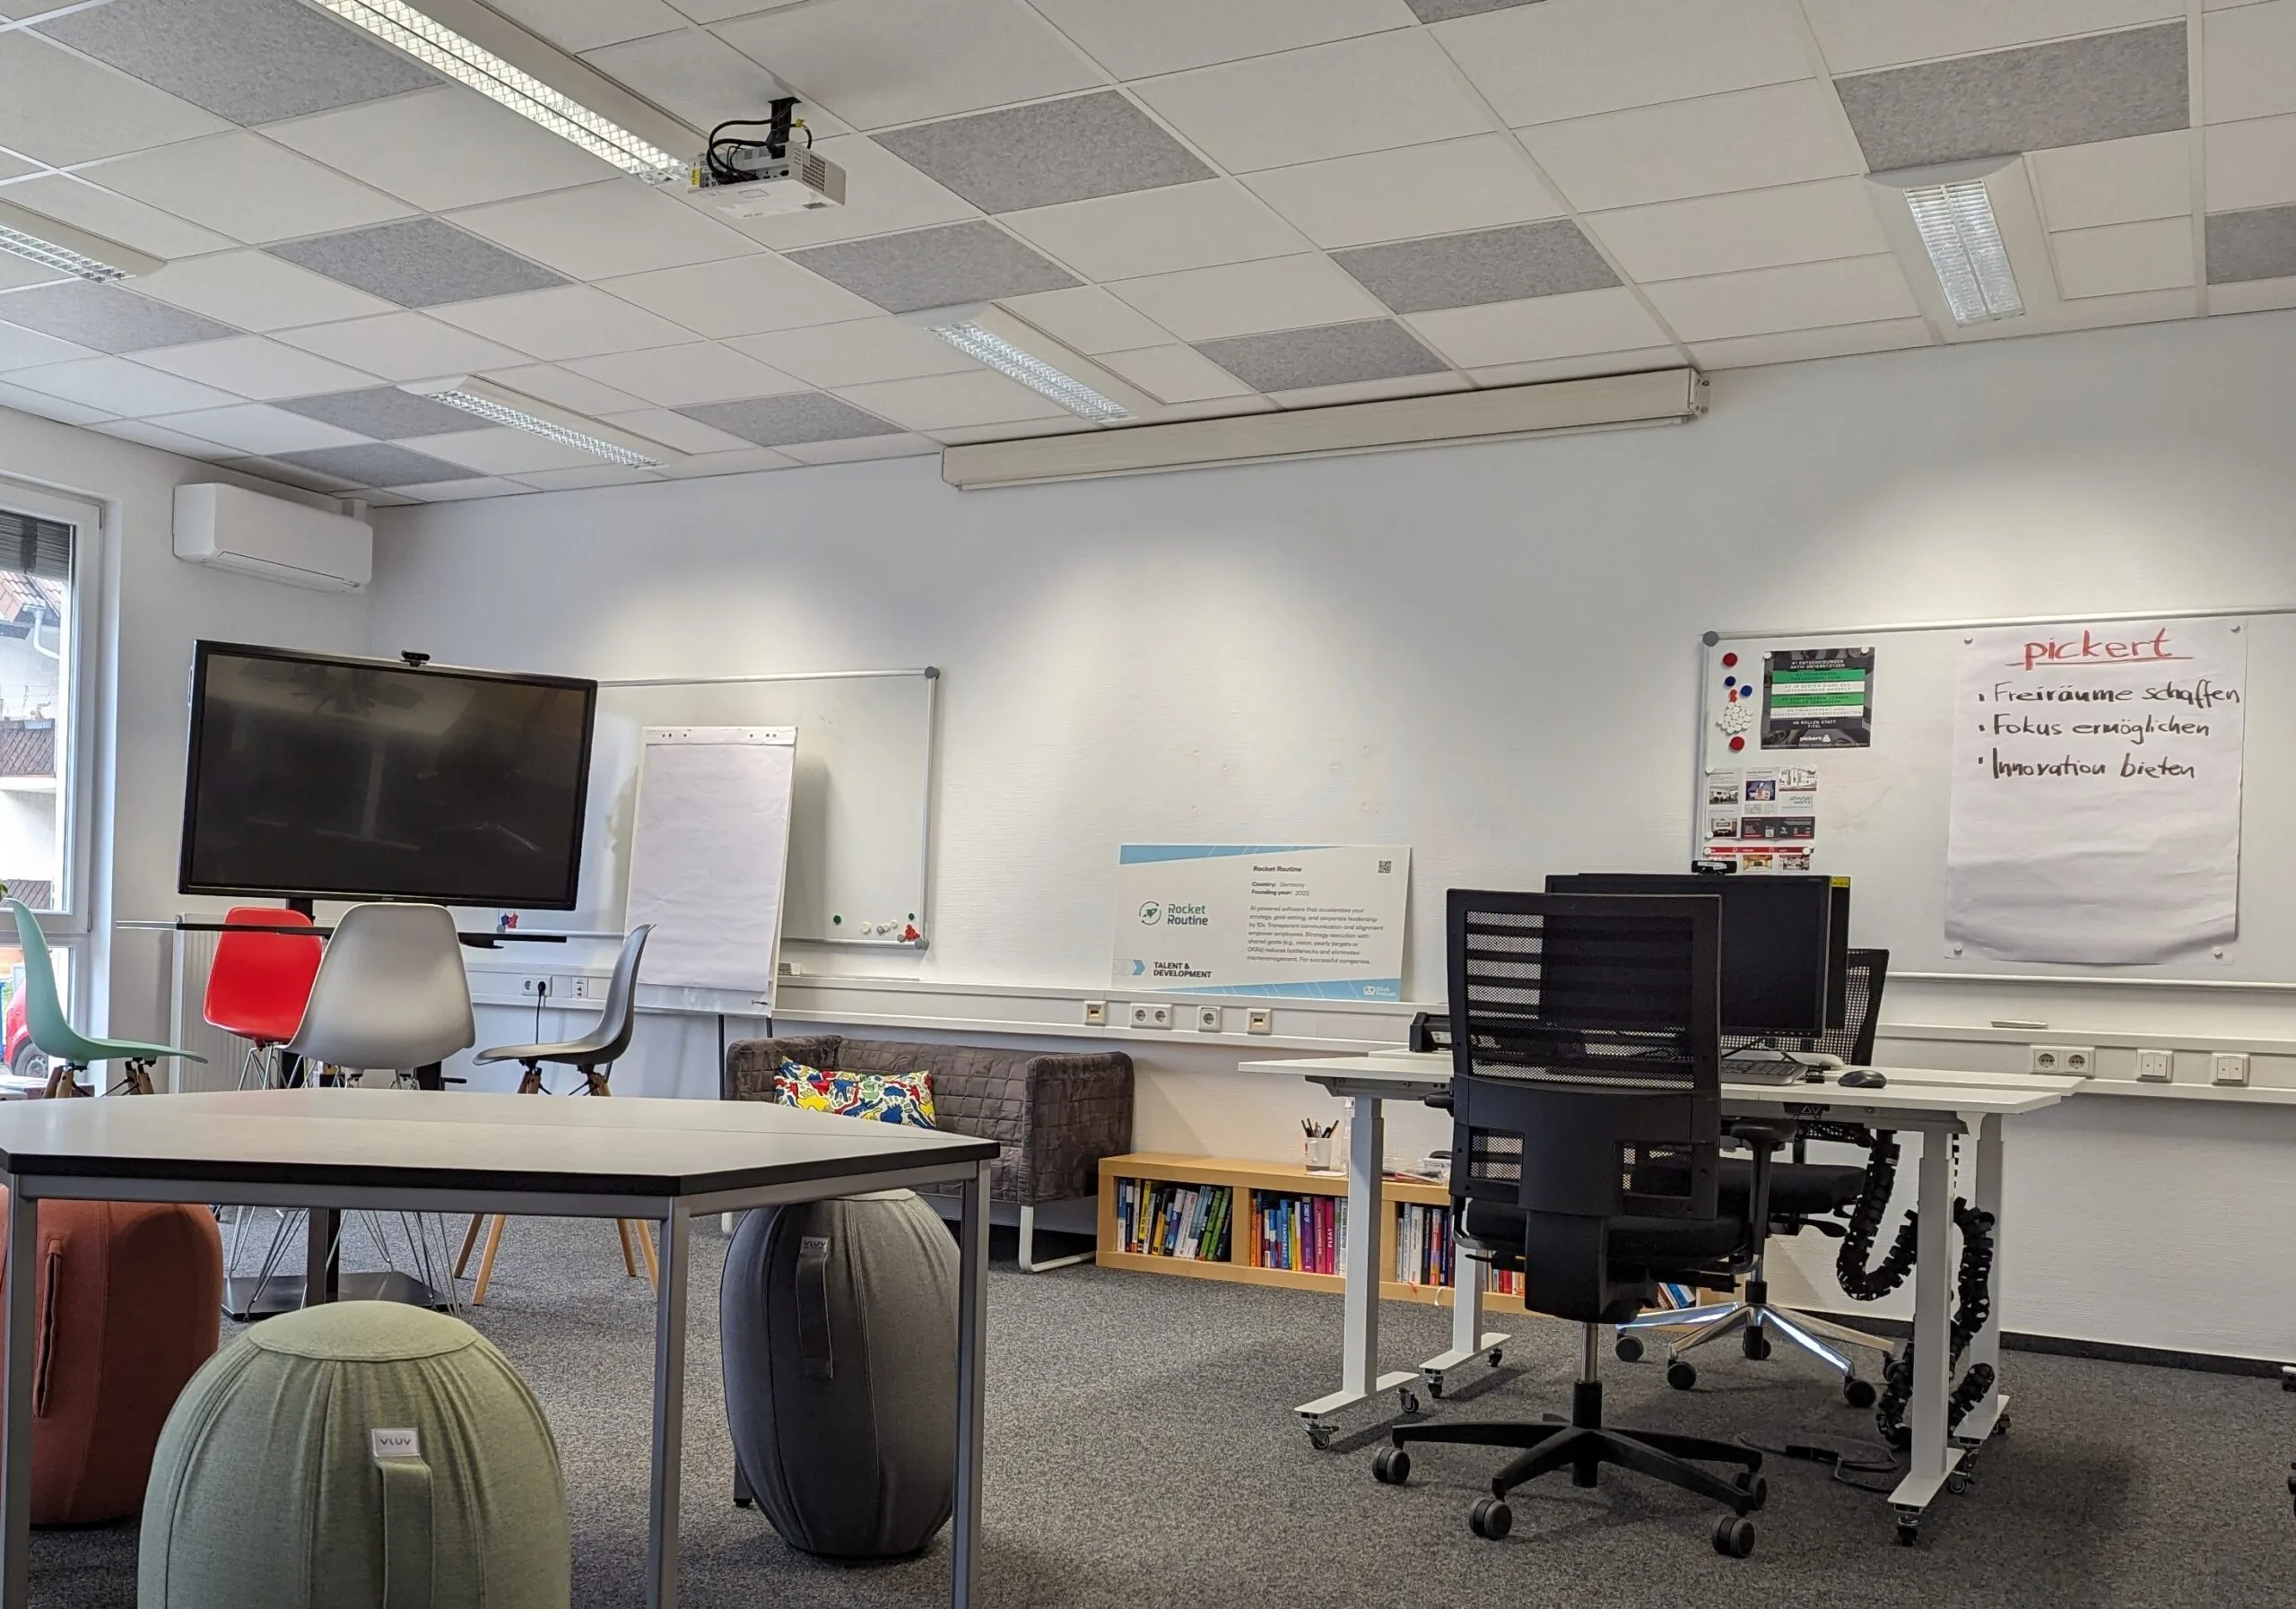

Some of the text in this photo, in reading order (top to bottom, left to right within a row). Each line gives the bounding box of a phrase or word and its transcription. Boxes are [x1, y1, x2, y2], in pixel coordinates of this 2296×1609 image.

[2022, 627, 2172, 671] pickert
[1995, 679, 2240, 709] Freiräume schaffen
[1994, 713, 2210, 745] Fokus ermöglichen
[1992, 747, 2196, 779] Innovation bieten
[1168, 903, 1206, 915] Rocket
[1167, 914, 1209, 926] Routine
[1153, 961, 1183, 970] TALENT
[1153, 969, 1213, 978] DEVELOPMENT
[380, 1438, 412, 1446] VLUV
